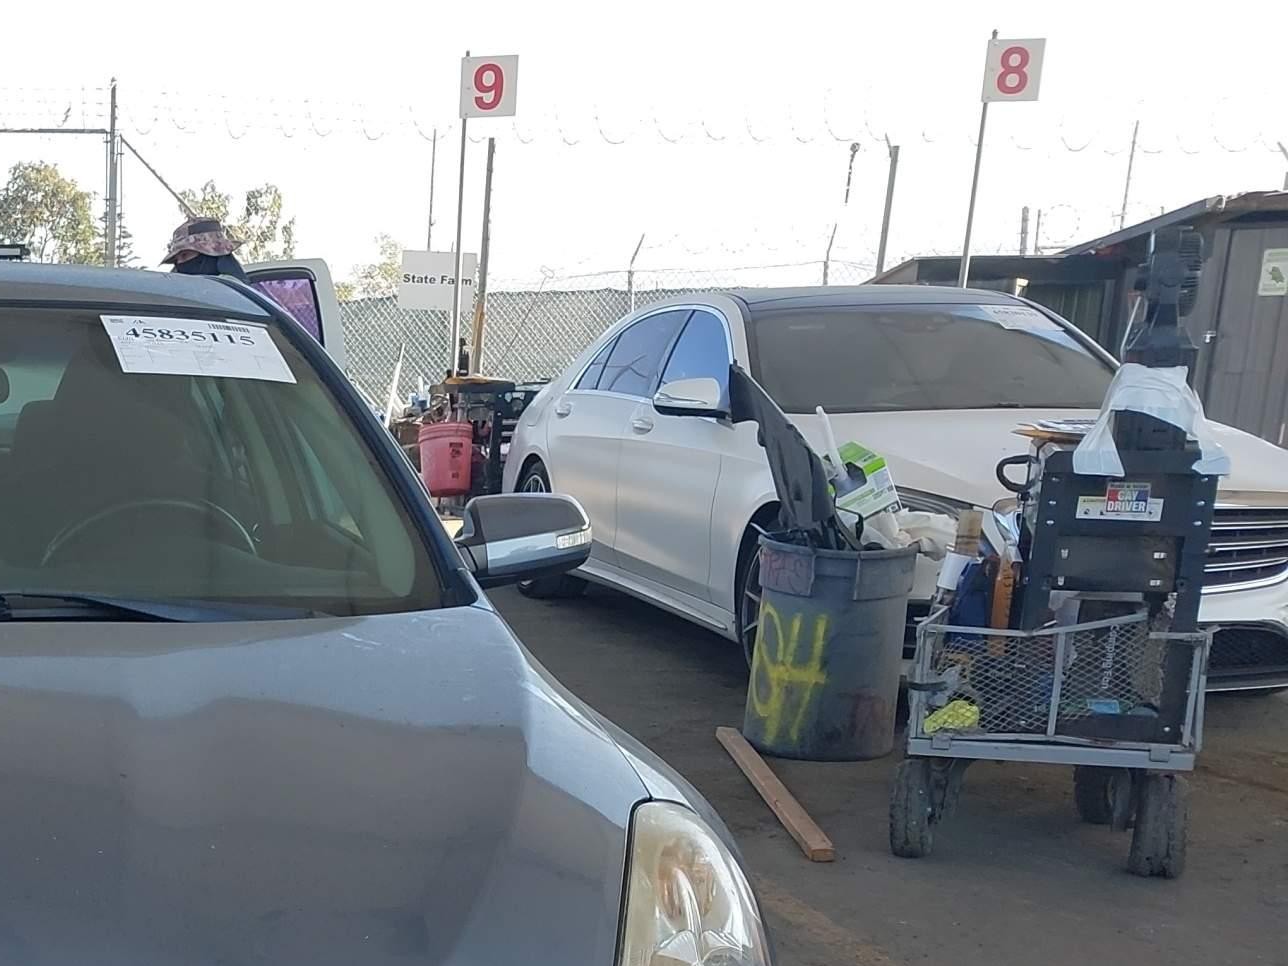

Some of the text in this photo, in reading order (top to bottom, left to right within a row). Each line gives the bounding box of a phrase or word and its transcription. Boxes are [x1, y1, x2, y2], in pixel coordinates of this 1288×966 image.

[996, 46, 1030, 94] 8
[473, 63, 504, 111] 9
[403, 273, 473, 286] State Fam
[125, 327, 256, 347] 45835115
[1106, 501, 1147, 512] DRIVER
